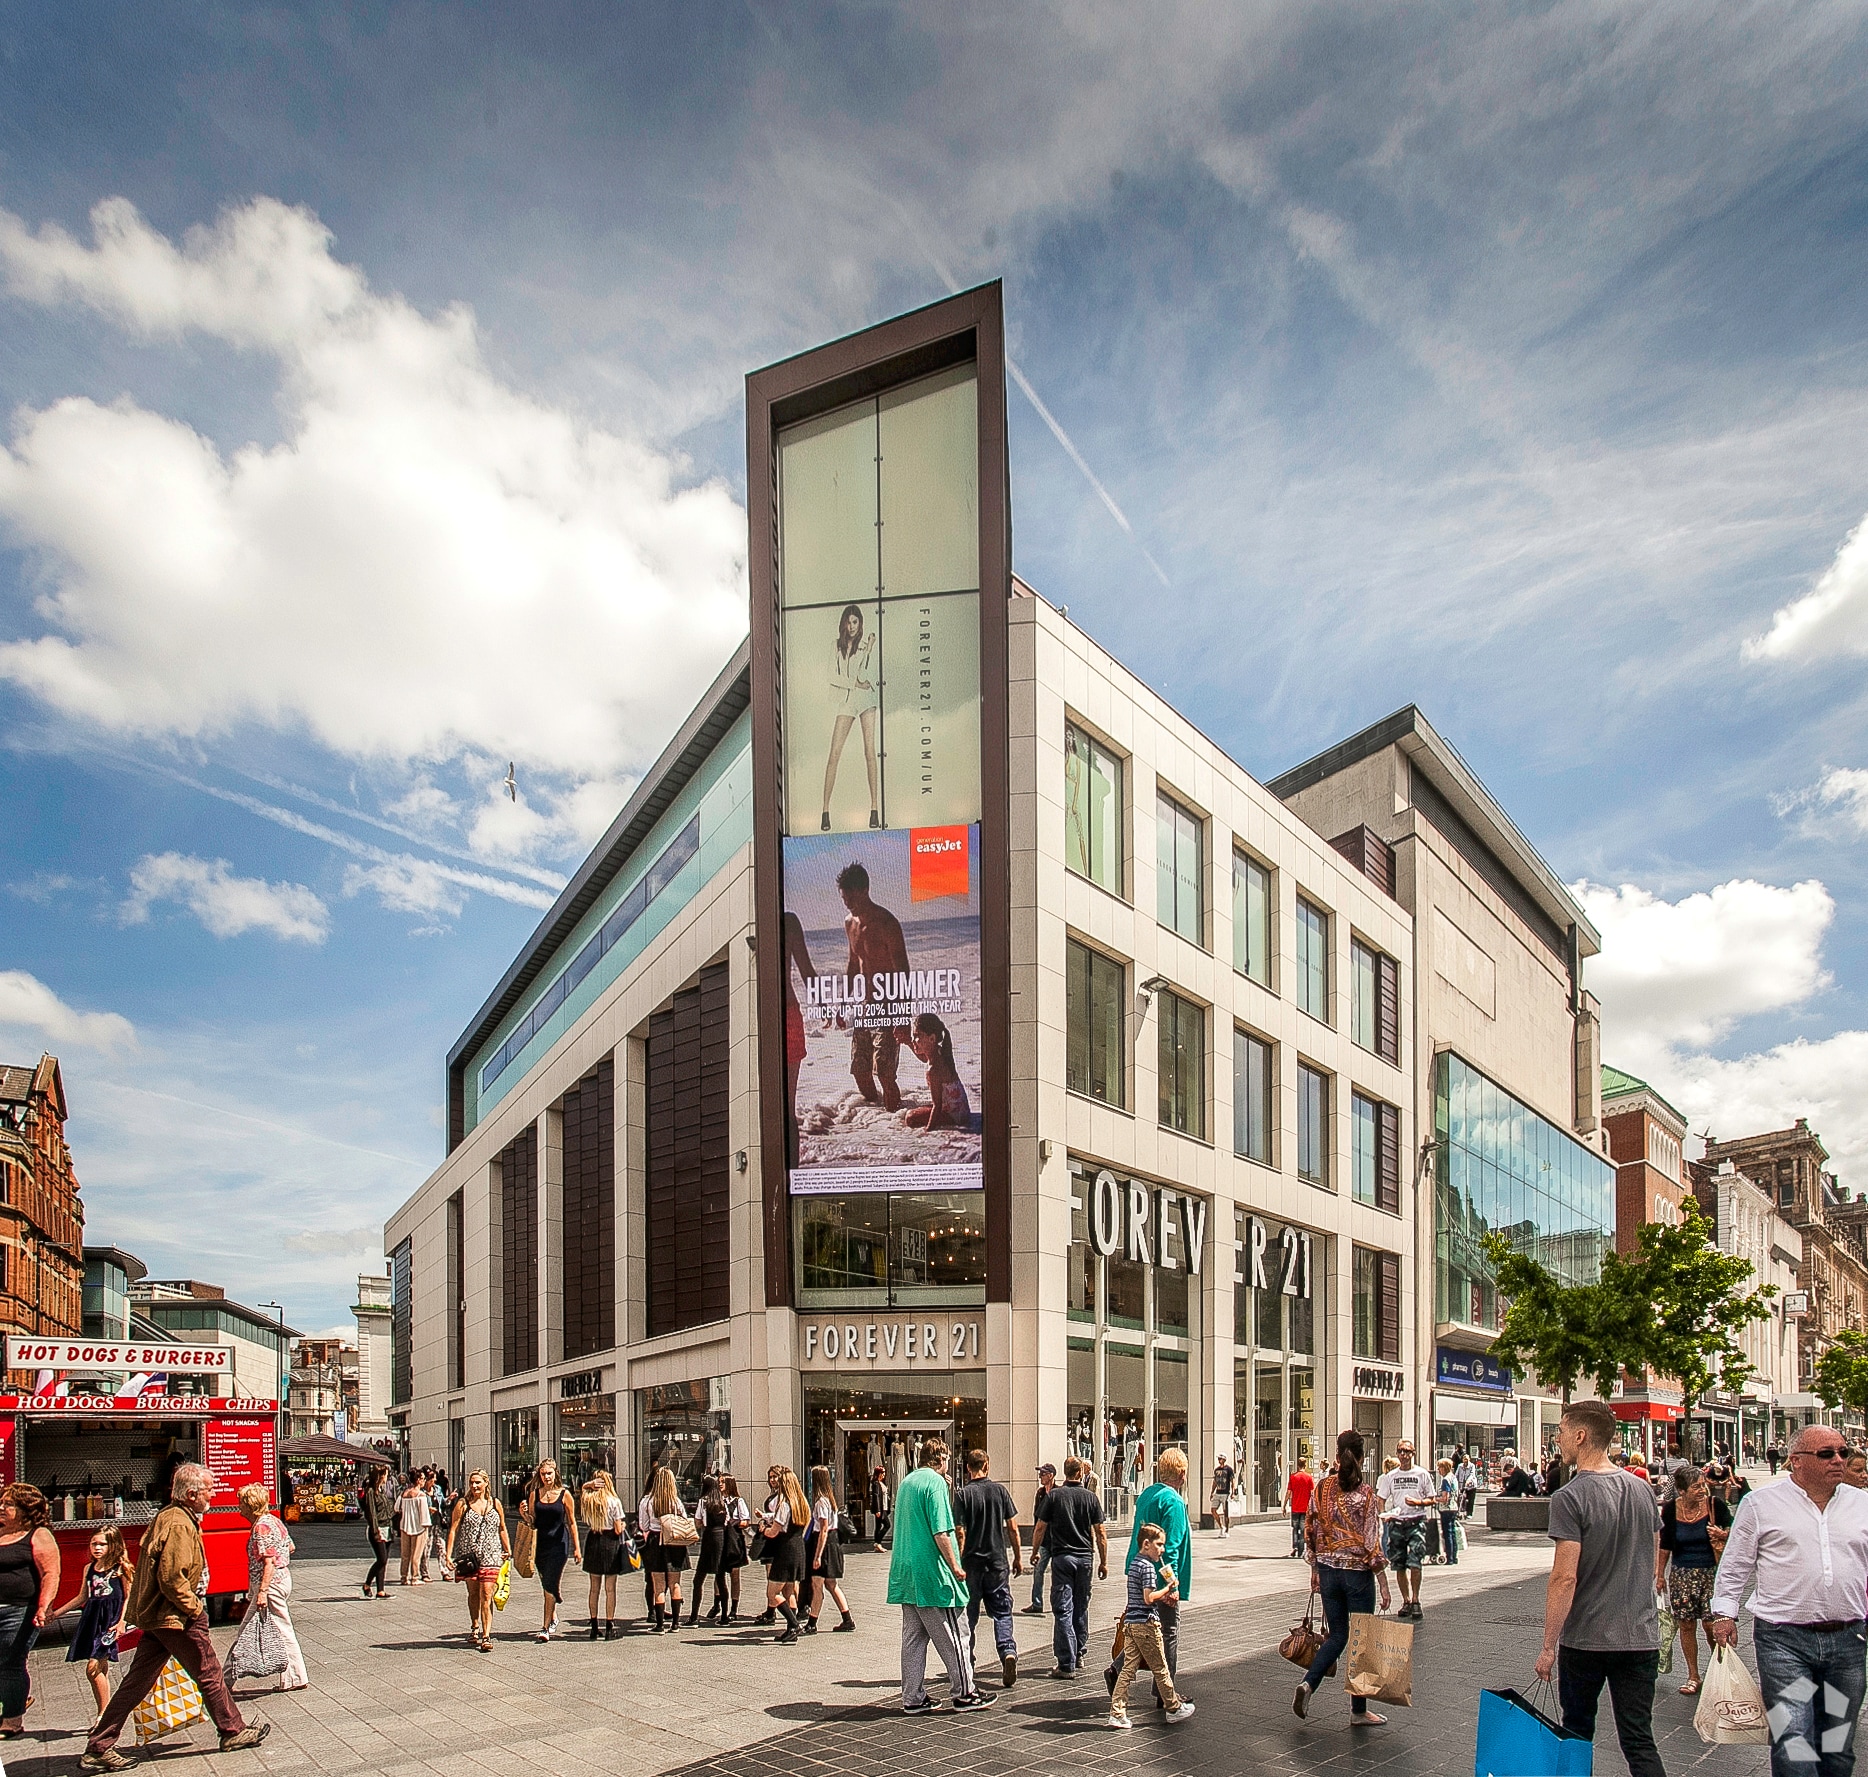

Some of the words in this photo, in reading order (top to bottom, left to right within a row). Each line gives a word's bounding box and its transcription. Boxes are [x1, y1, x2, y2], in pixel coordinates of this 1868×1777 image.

[916, 839, 962, 854] easyJet
[806, 974, 867, 1005] HELLO
[872, 969, 961, 1000] SUMMER
[807, 1004, 837, 1020] PRICES
[839, 1004, 851, 1018] UP
[852, 1003, 863, 1017] TO
[865, 1002, 886, 1017] 20%
[888, 1001, 917, 1016] LOWER
[917, 1000, 938, 1014] THIS
[939, 999, 962, 1013] YEAR
[854, 1018, 863, 1028] ON
[863, 1017, 891, 1028] SELECTED
[908, 1230, 926, 1246] FOR
[903, 1242, 926, 1260] EVER
[1279, 1226, 1310, 1299] 21
[805, 1324, 938, 1359] FOREVER
[951, 1322, 979, 1357] 21
[17, 1344, 60, 1361] HOT
[67, 1346, 119, 1363] DOGS
[125, 1348, 137, 1364] &
[142, 1349, 226, 1366] BURGERS
[16, 1395, 61, 1409] HOT
[63, 1395, 115, 1409] DOGS
[134, 1396, 210, 1410] BURGERS
[225, 1398, 271, 1411] CHIPS
[1301, 1443, 1309, 1455] B
